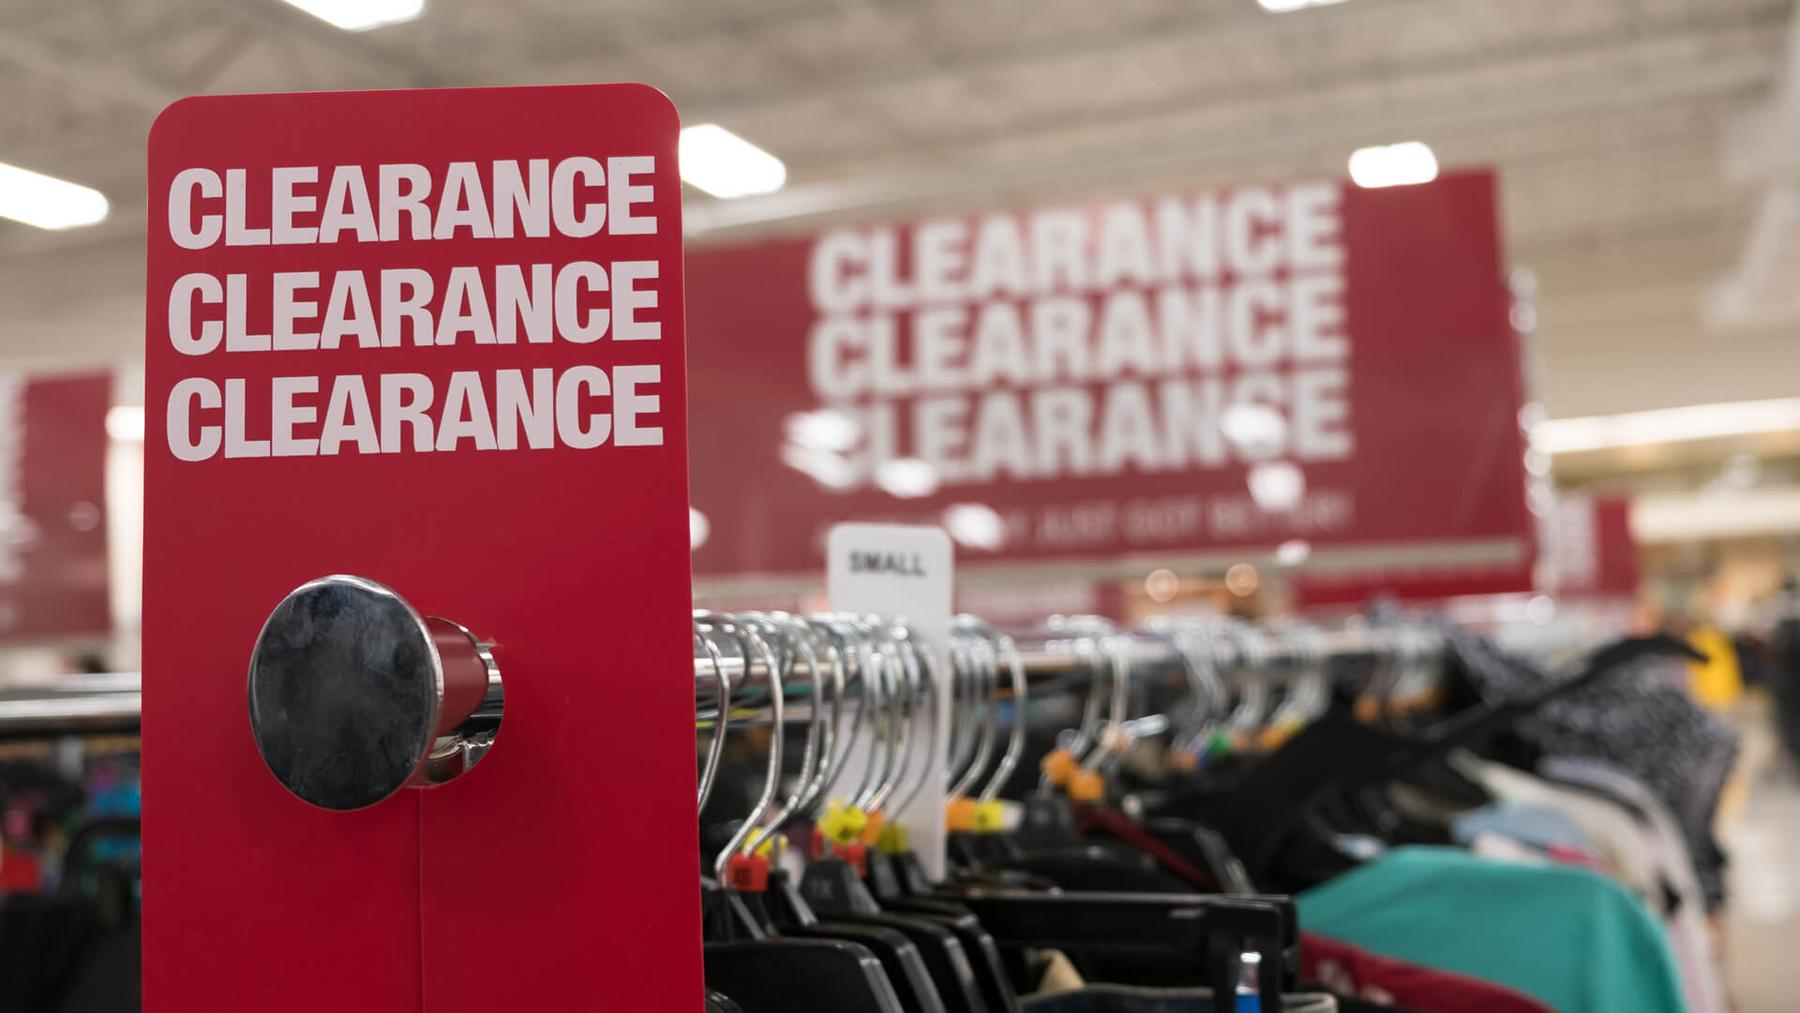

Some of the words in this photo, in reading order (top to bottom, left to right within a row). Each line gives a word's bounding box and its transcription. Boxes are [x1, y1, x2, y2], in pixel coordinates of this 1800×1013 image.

[168, 156, 657, 249] CLEARANCE
[808, 182, 1344, 314] CLEARANCE
[168, 260, 661, 355] CLEARANCE
[808, 275, 1348, 399] CLEARANCE
[166, 364, 664, 461] CLEARANCE
[848, 550, 928, 577] SMALL
